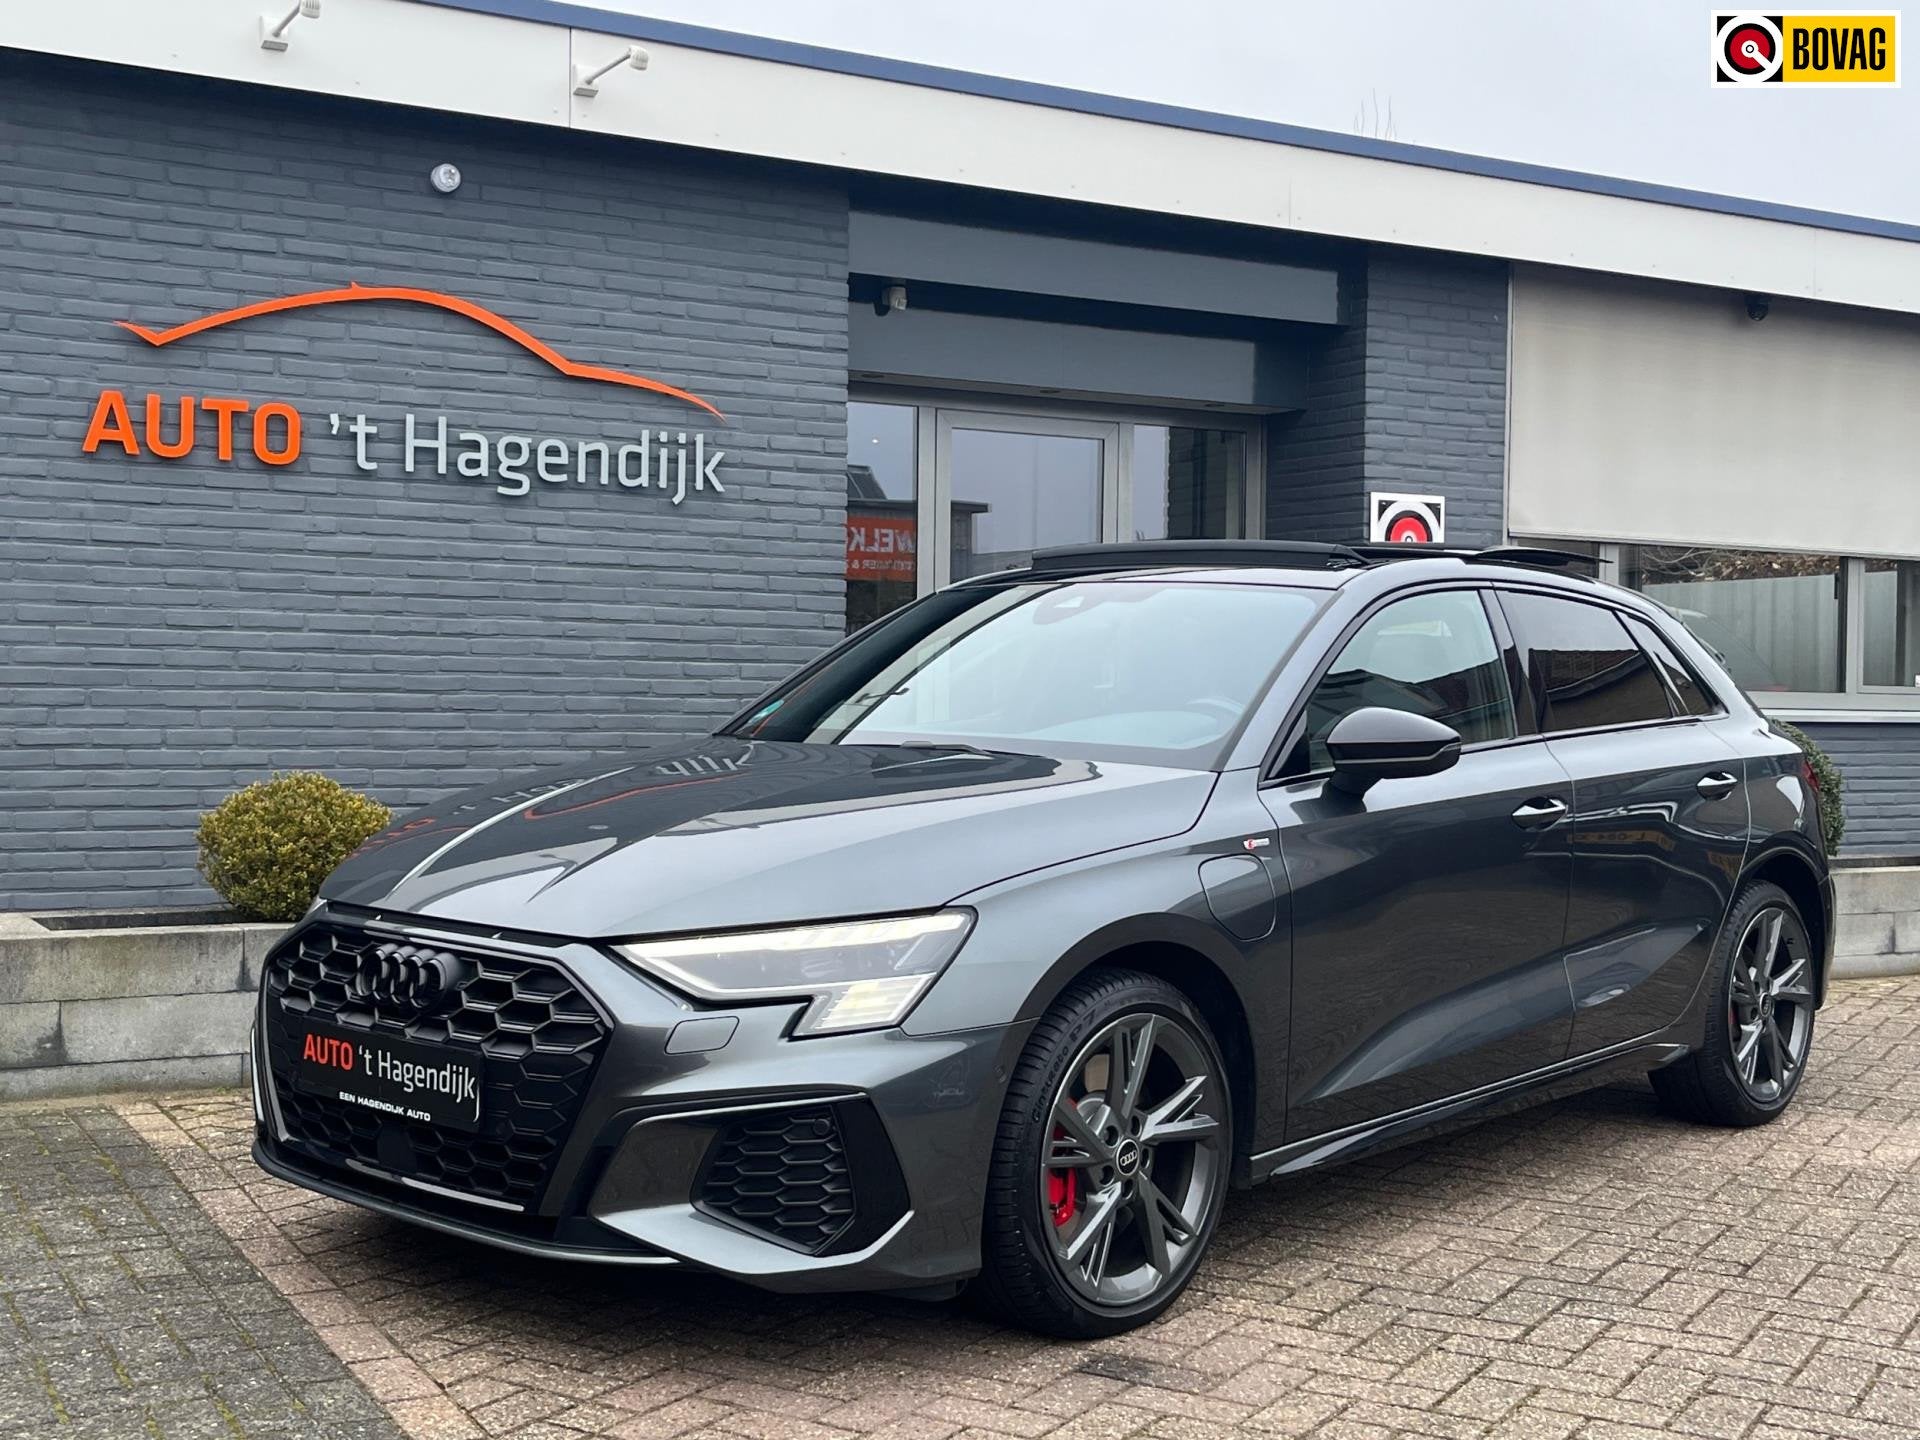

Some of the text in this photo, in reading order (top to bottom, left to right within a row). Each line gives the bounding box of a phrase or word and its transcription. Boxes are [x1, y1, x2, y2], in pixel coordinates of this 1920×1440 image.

[82, 390, 726, 505] AUTO 't Hagendijk
[303, 1034, 475, 1104] AUTO 't Hagendijk
[339, 1091, 431, 1122] EEN HAGENDIJK AUTO
